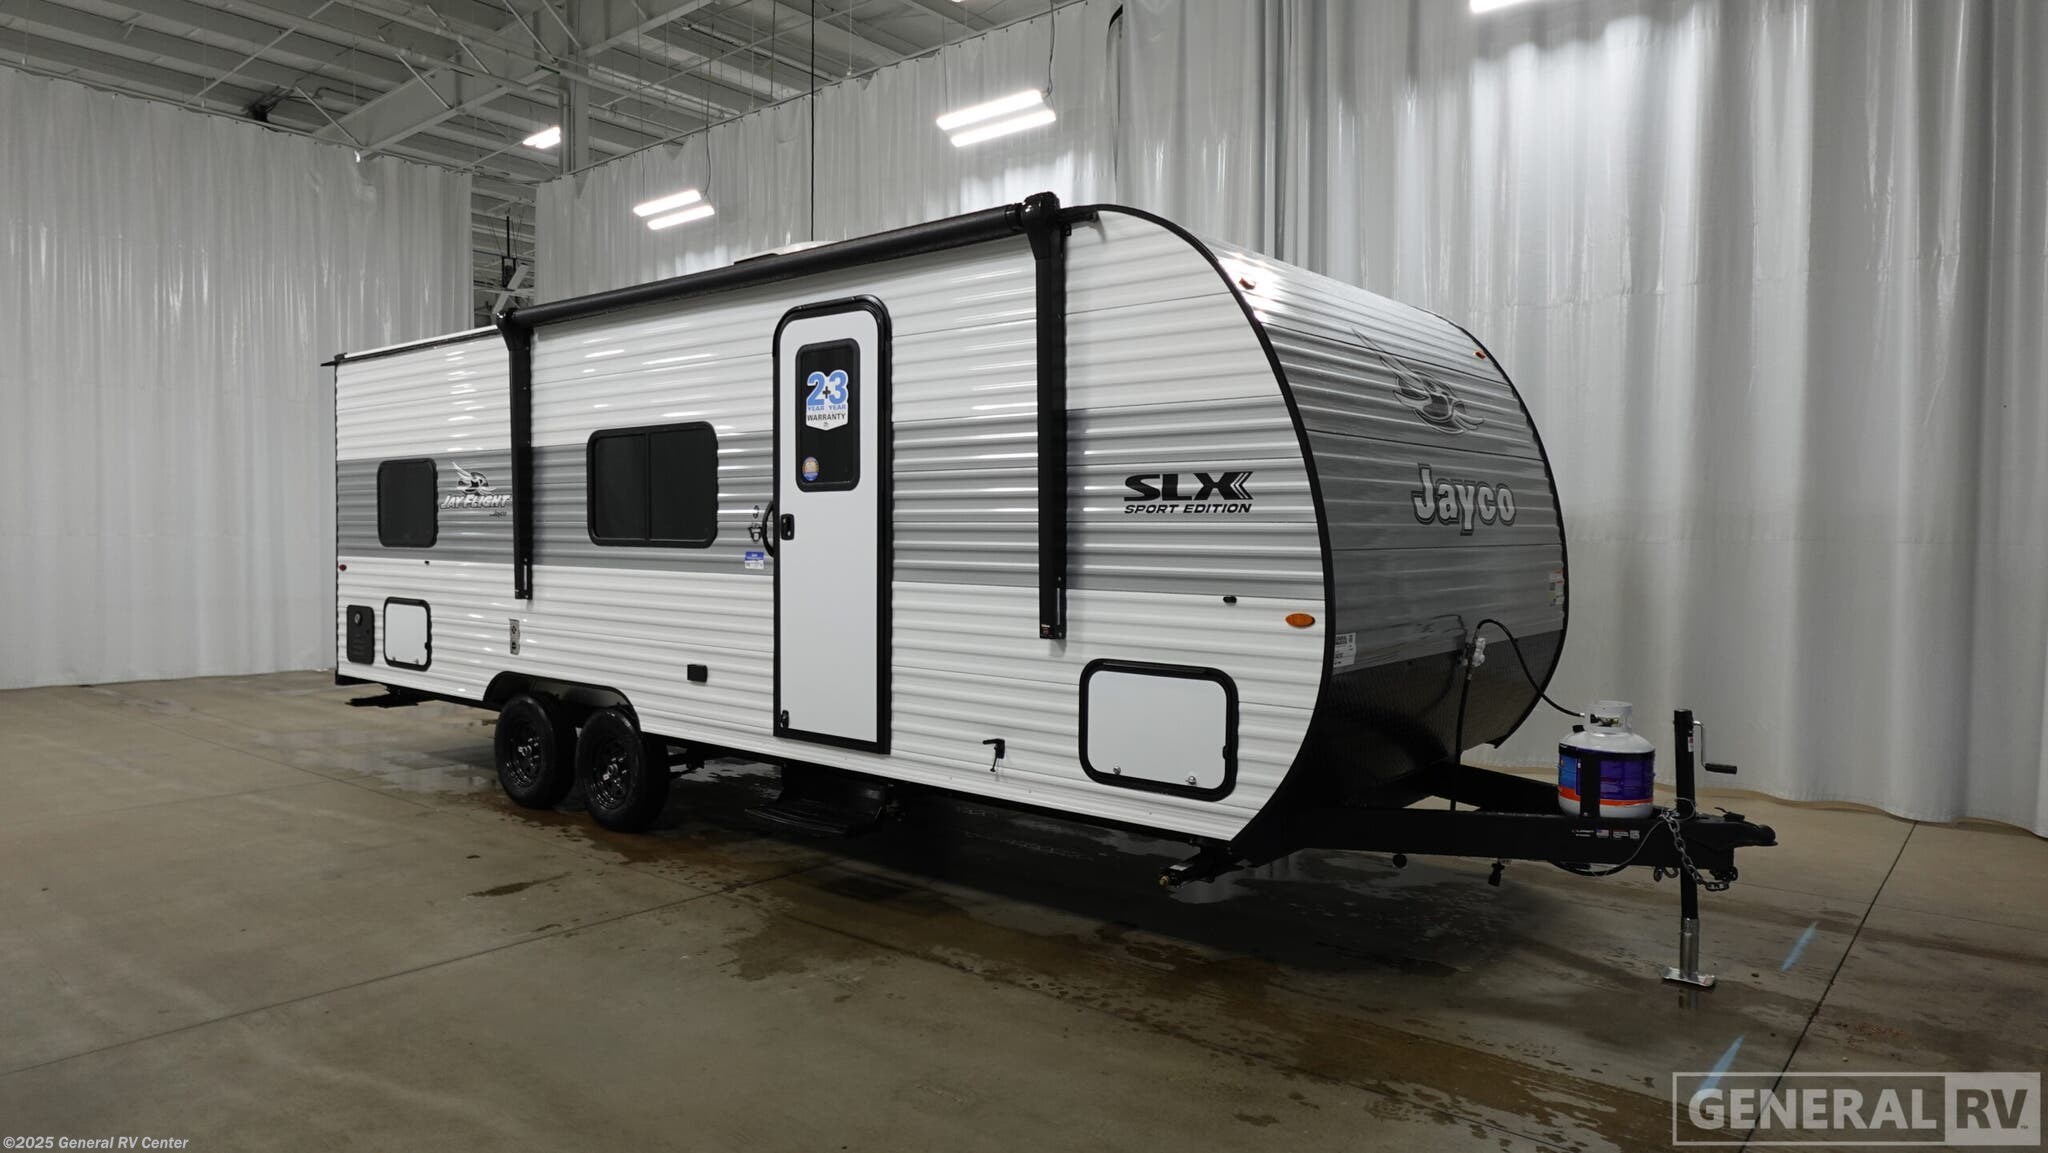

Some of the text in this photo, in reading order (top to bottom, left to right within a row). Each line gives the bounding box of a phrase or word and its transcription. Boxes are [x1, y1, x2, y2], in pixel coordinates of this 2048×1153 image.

[808, 413, 846, 421] WARRANTY
[1124, 471, 1254, 501] SLX
[440, 494, 510, 509] JAY FLIGHT
[1411, 463, 1516, 536] Jayco
[1124, 503, 1252, 514] SPORT EDITION
